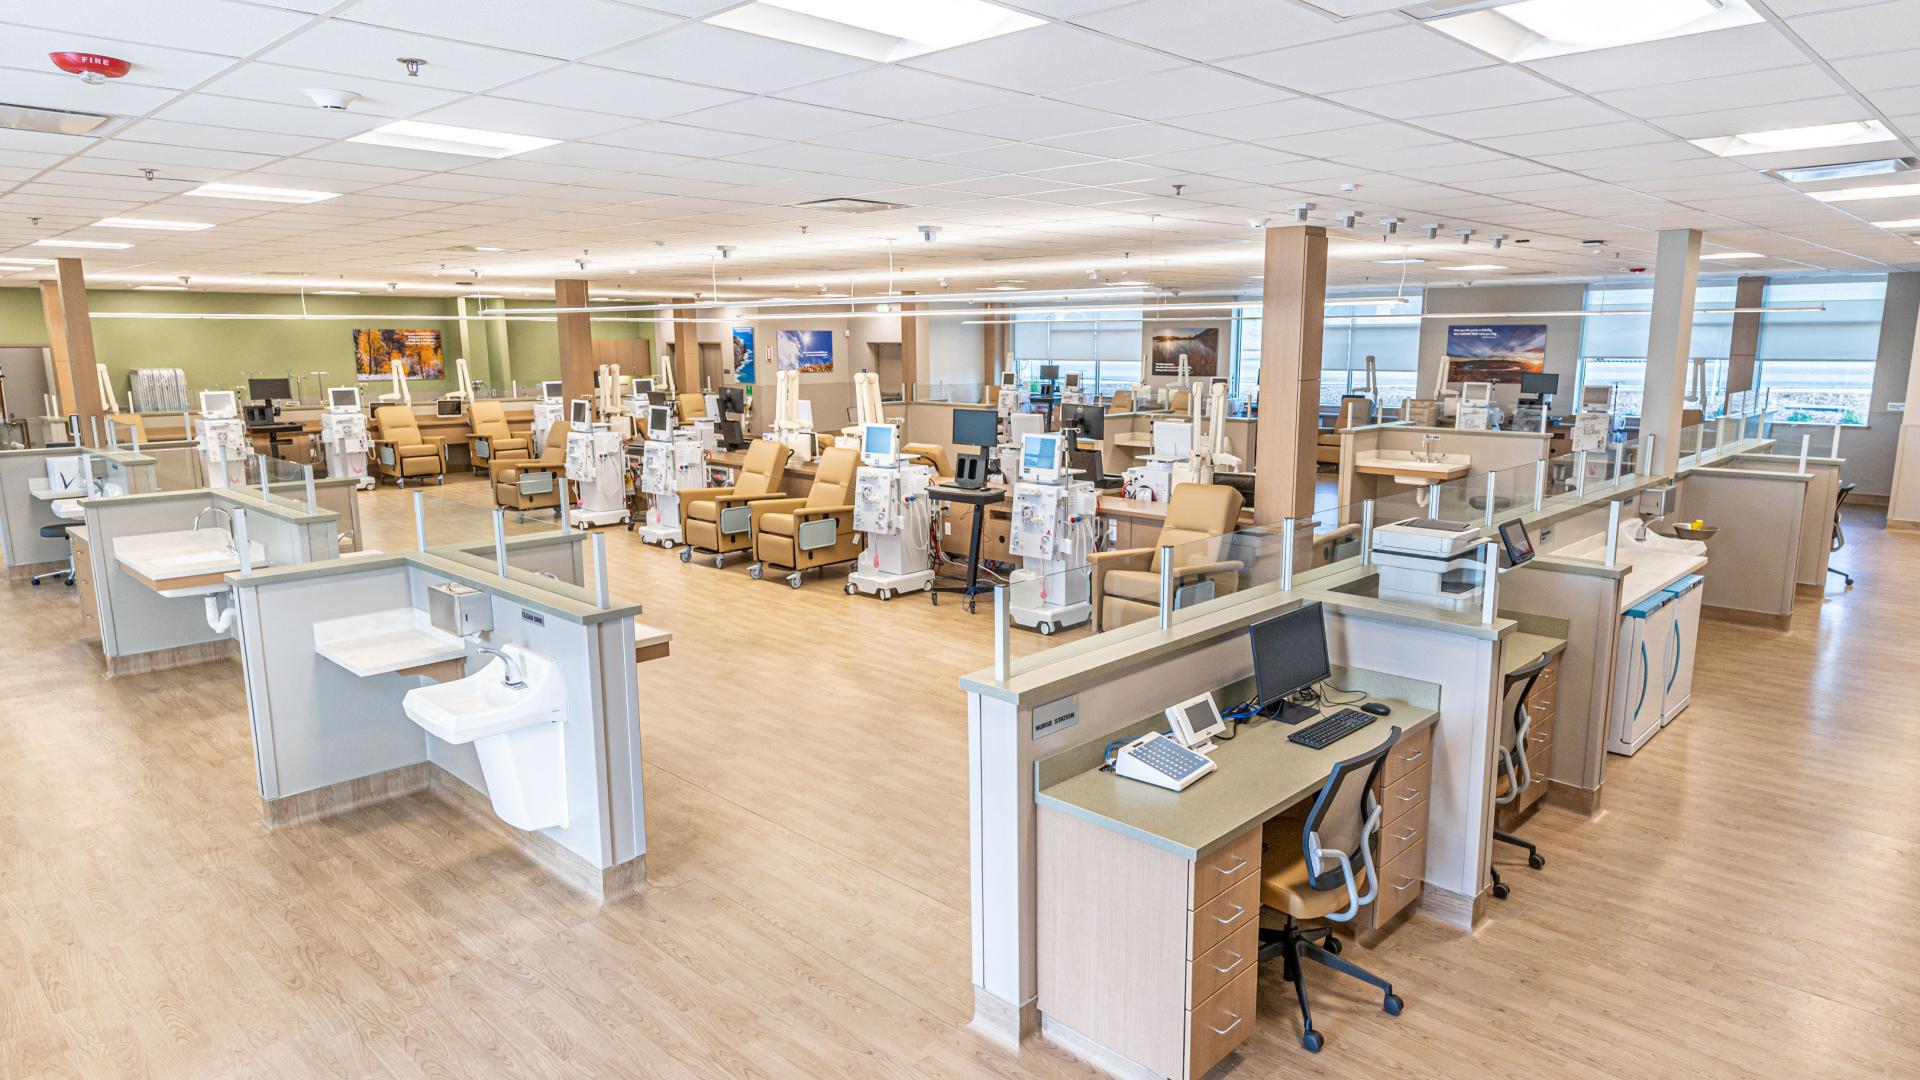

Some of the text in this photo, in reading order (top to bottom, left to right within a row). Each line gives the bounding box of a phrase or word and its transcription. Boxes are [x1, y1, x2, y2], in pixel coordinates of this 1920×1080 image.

[81, 56, 109, 66] FIRE
[1035, 712, 1075, 731] NURSE STATION
